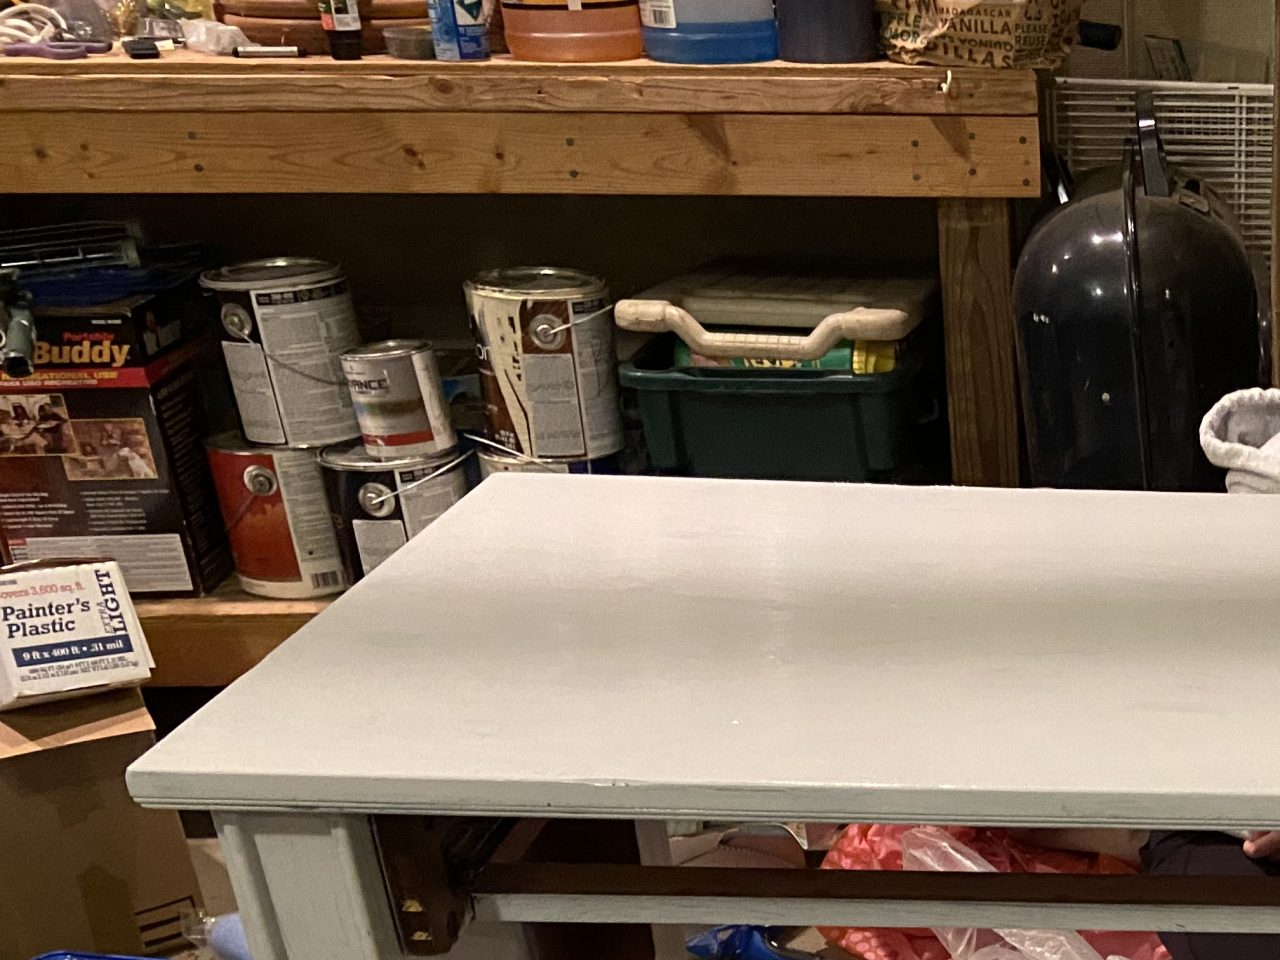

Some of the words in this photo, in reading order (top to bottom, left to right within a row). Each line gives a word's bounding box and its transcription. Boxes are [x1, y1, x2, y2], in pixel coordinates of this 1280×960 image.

[940, 17, 1011, 35] VANILLA
[33, 340, 130, 367] Buddy
[31, 584, 59, 596] 3,600
[2, 598, 91, 622] Painter's
[94, 569, 128, 635] LIGHT
[96, 600, 115, 634] EXTRA
[7, 618, 76, 639] Plastic
[22, 651, 30, 661] 9
[32, 650, 43, 660] ft
[51, 647, 69, 657] 400
[71, 645, 80, 655] ft
[106, 640, 124, 650] mil
